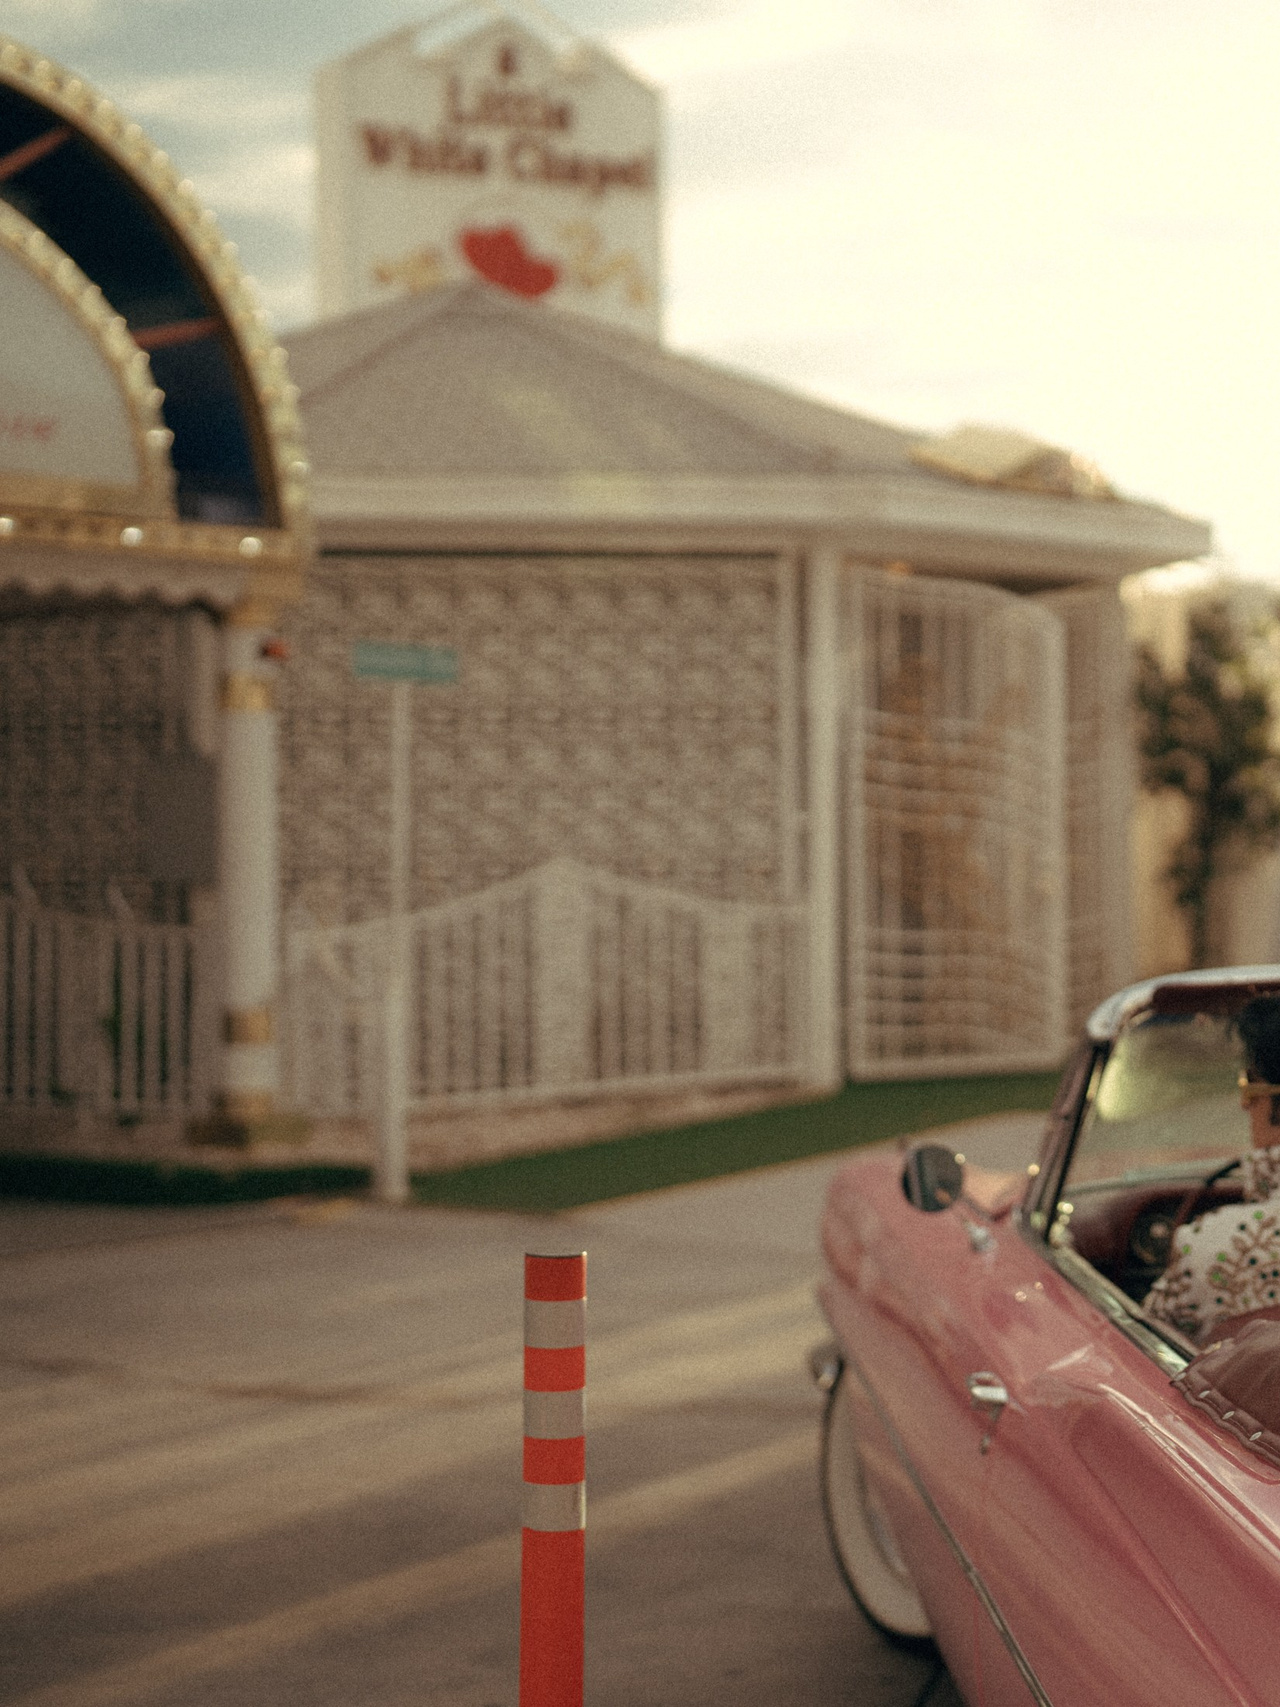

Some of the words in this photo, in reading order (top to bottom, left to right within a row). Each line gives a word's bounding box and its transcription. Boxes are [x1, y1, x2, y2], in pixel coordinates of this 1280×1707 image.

[446, 75, 571, 131] Little
[361, 122, 487, 176] White
[506, 134, 654, 198] Chapel
